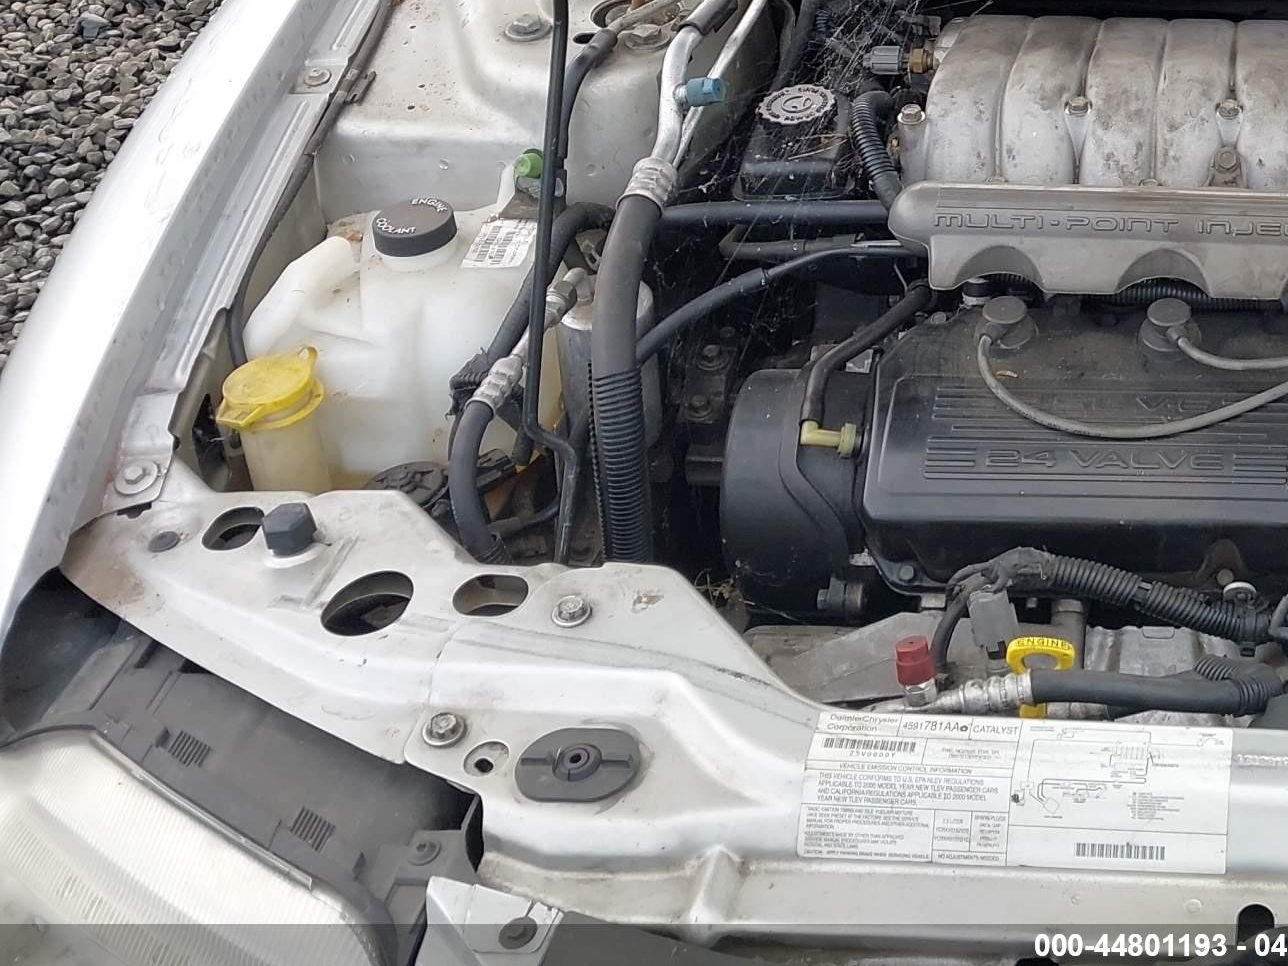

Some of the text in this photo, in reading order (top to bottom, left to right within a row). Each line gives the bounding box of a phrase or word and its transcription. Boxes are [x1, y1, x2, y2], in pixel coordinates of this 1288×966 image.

[411, 198, 448, 212] ENGINE
[376, 217, 417, 234] COOLANT
[985, 449, 1225, 471] 24 VALVE
[826, 722, 878, 732] Corporation
[973, 725, 1020, 735] CATALYST
